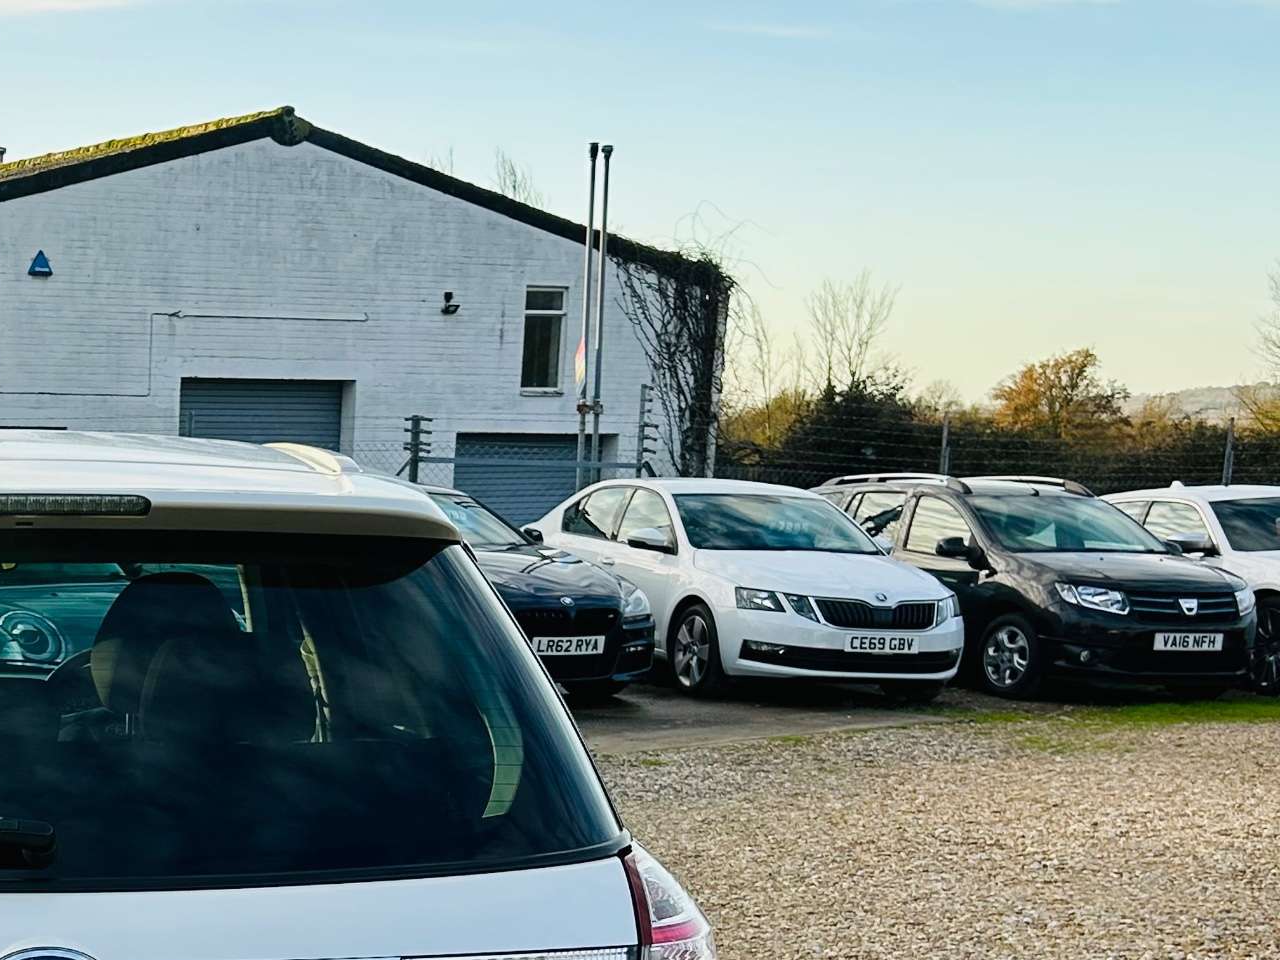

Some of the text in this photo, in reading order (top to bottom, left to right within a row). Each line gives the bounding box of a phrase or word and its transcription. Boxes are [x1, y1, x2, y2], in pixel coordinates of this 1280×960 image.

[536, 638, 599, 653] LR62 RYA
[850, 636, 914, 651] CE69 GBV
[1163, 634, 1217, 649] VA16 NFH
